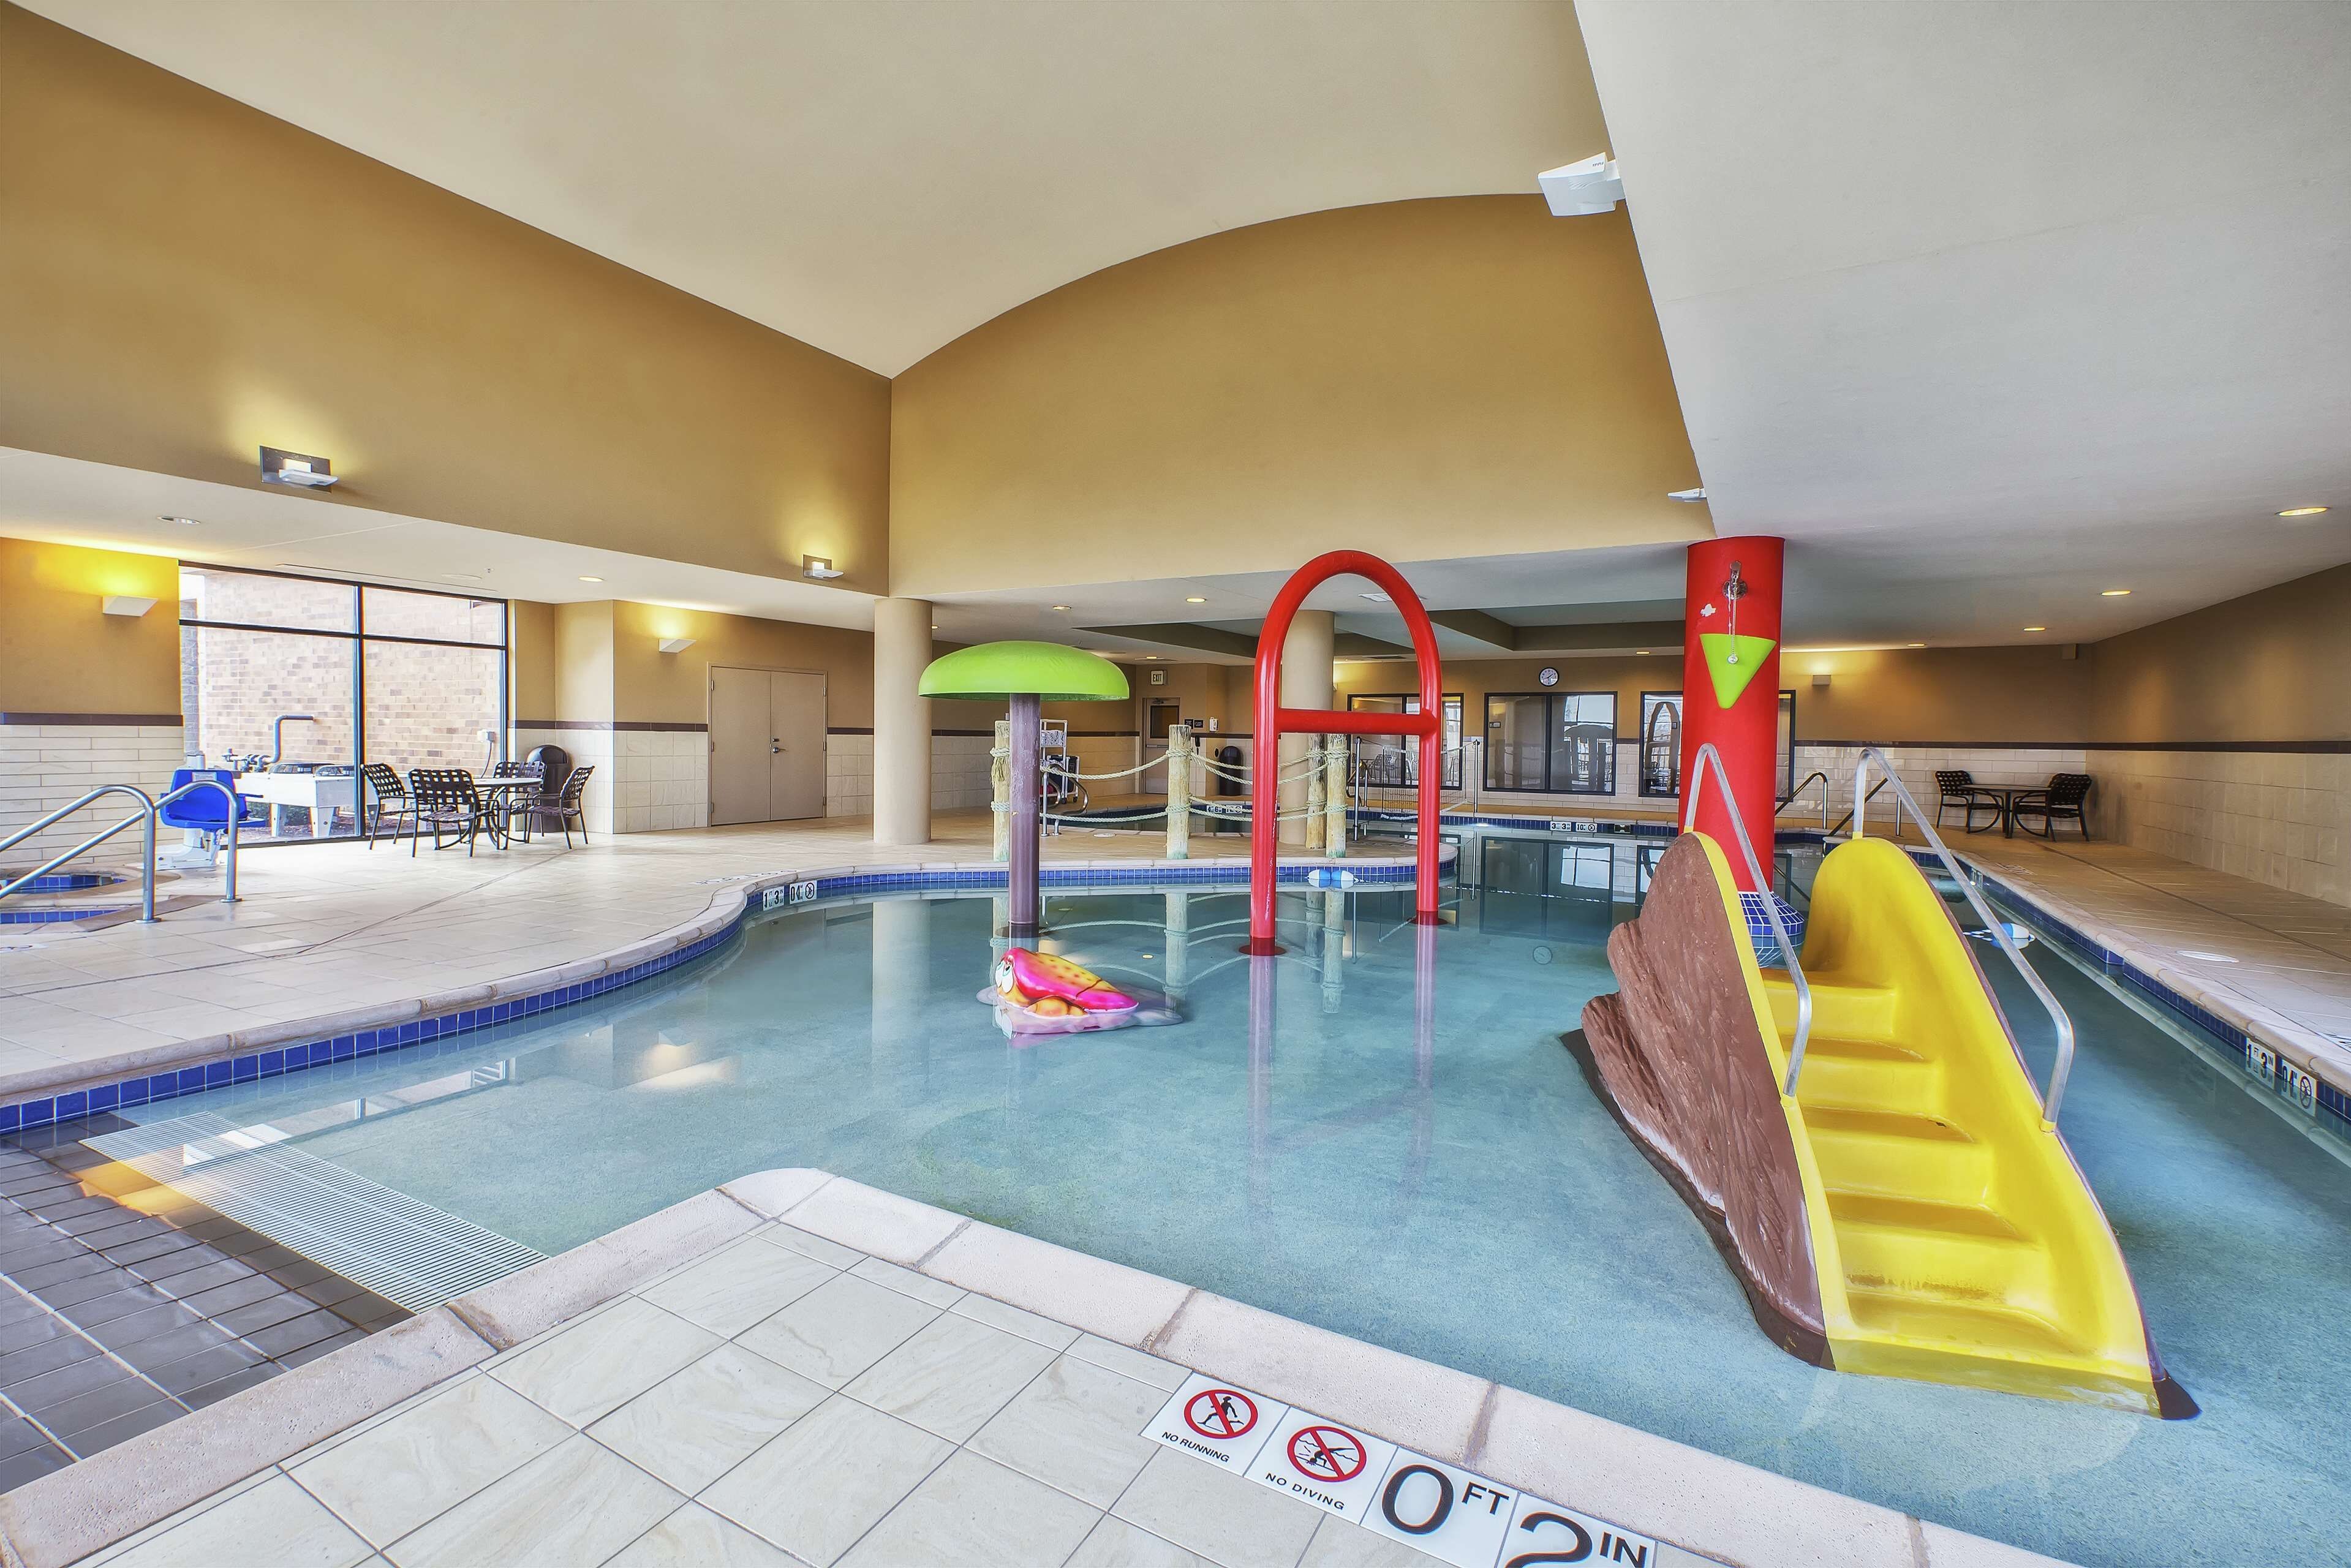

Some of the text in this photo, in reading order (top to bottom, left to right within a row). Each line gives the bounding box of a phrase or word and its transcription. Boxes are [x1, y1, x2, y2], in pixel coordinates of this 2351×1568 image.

[764, 892, 768, 908] 1
[774, 890, 780, 905] 3
[1162, 1431, 1230, 1462] NO RUNNING
[1265, 1472, 1345, 1510] NO DIVING
[1381, 1464, 1648, 1568] 0 FT 2 IN
